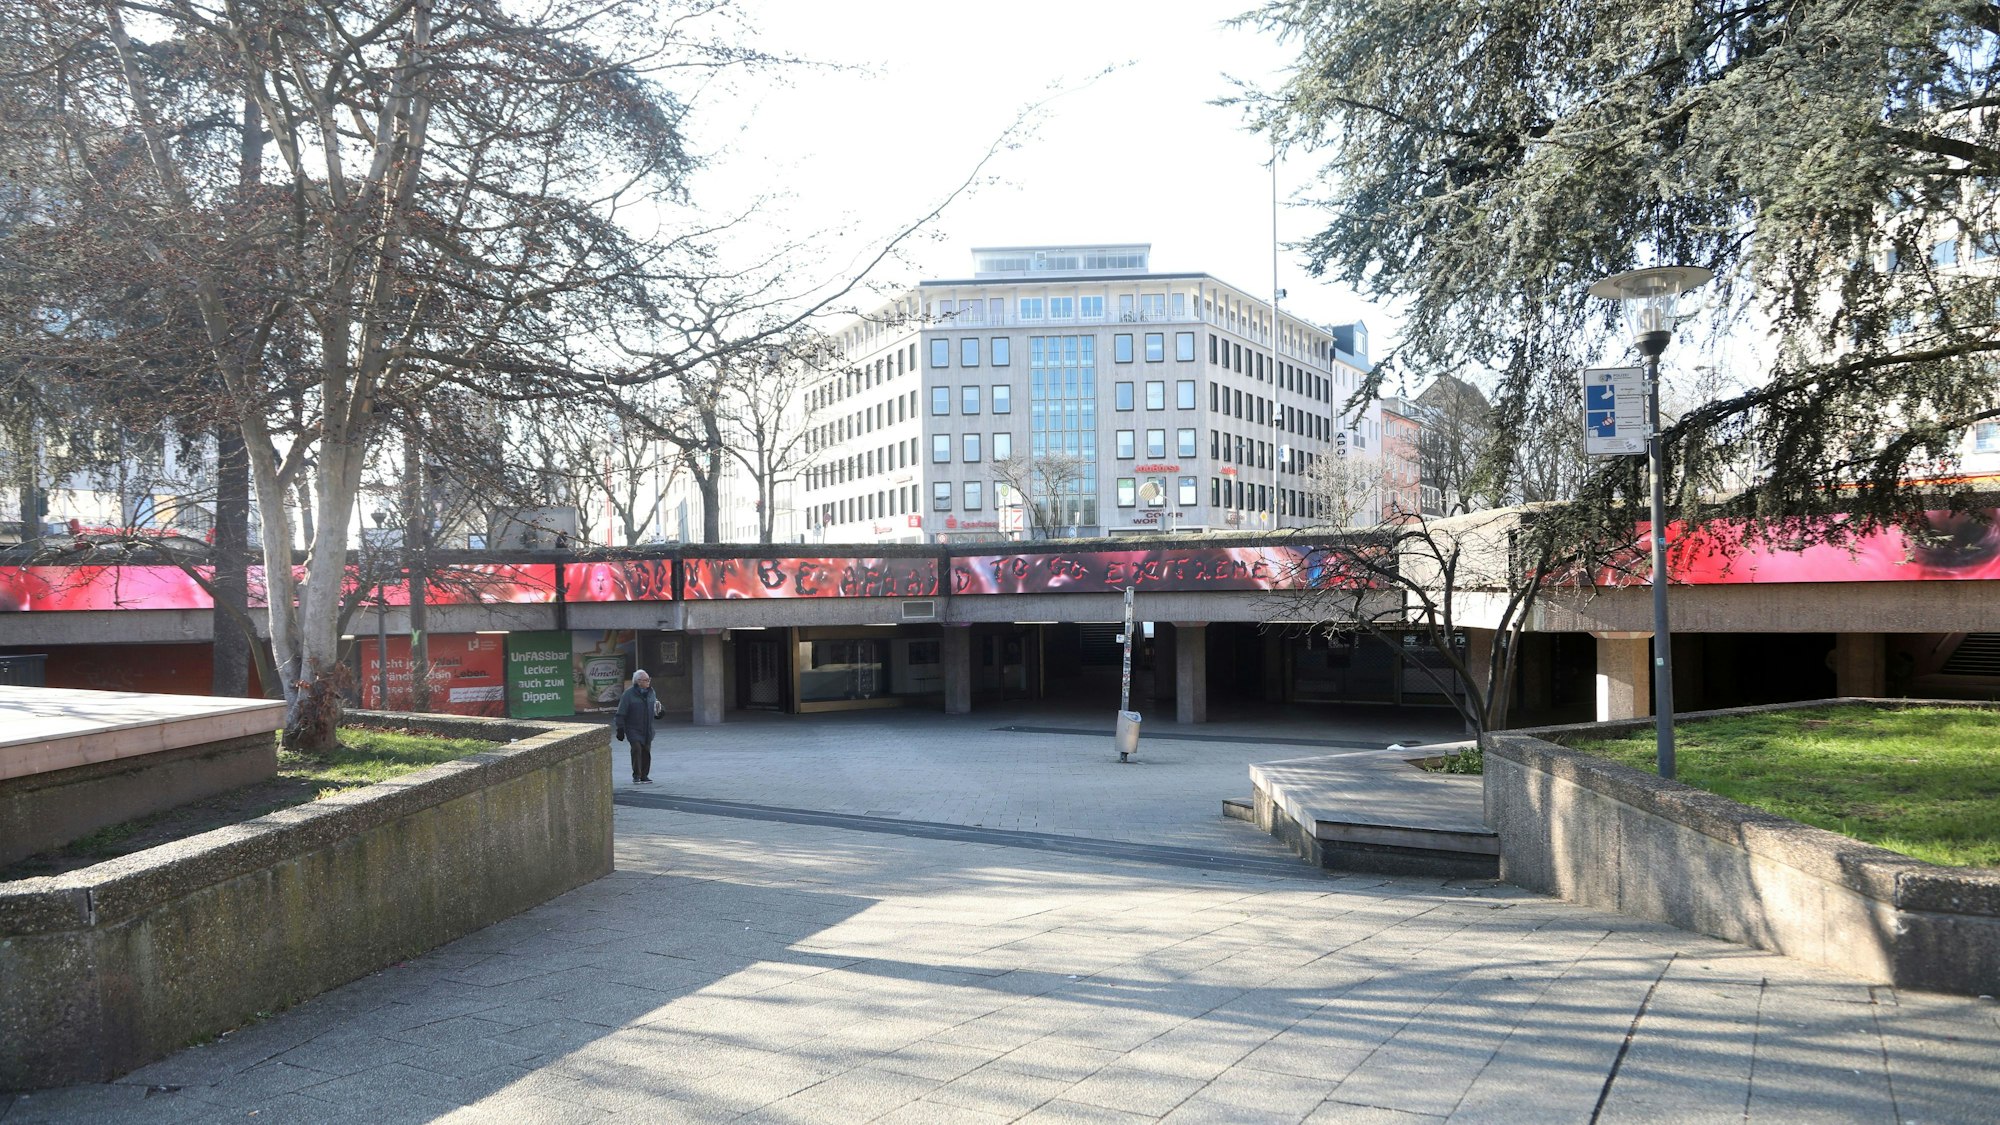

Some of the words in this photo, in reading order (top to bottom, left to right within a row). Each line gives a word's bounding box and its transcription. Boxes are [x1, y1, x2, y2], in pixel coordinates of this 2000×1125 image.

[990, 557, 1030, 584] TO
[371, 659, 402, 669] Ncht
[522, 691, 561, 703] Dippen.
